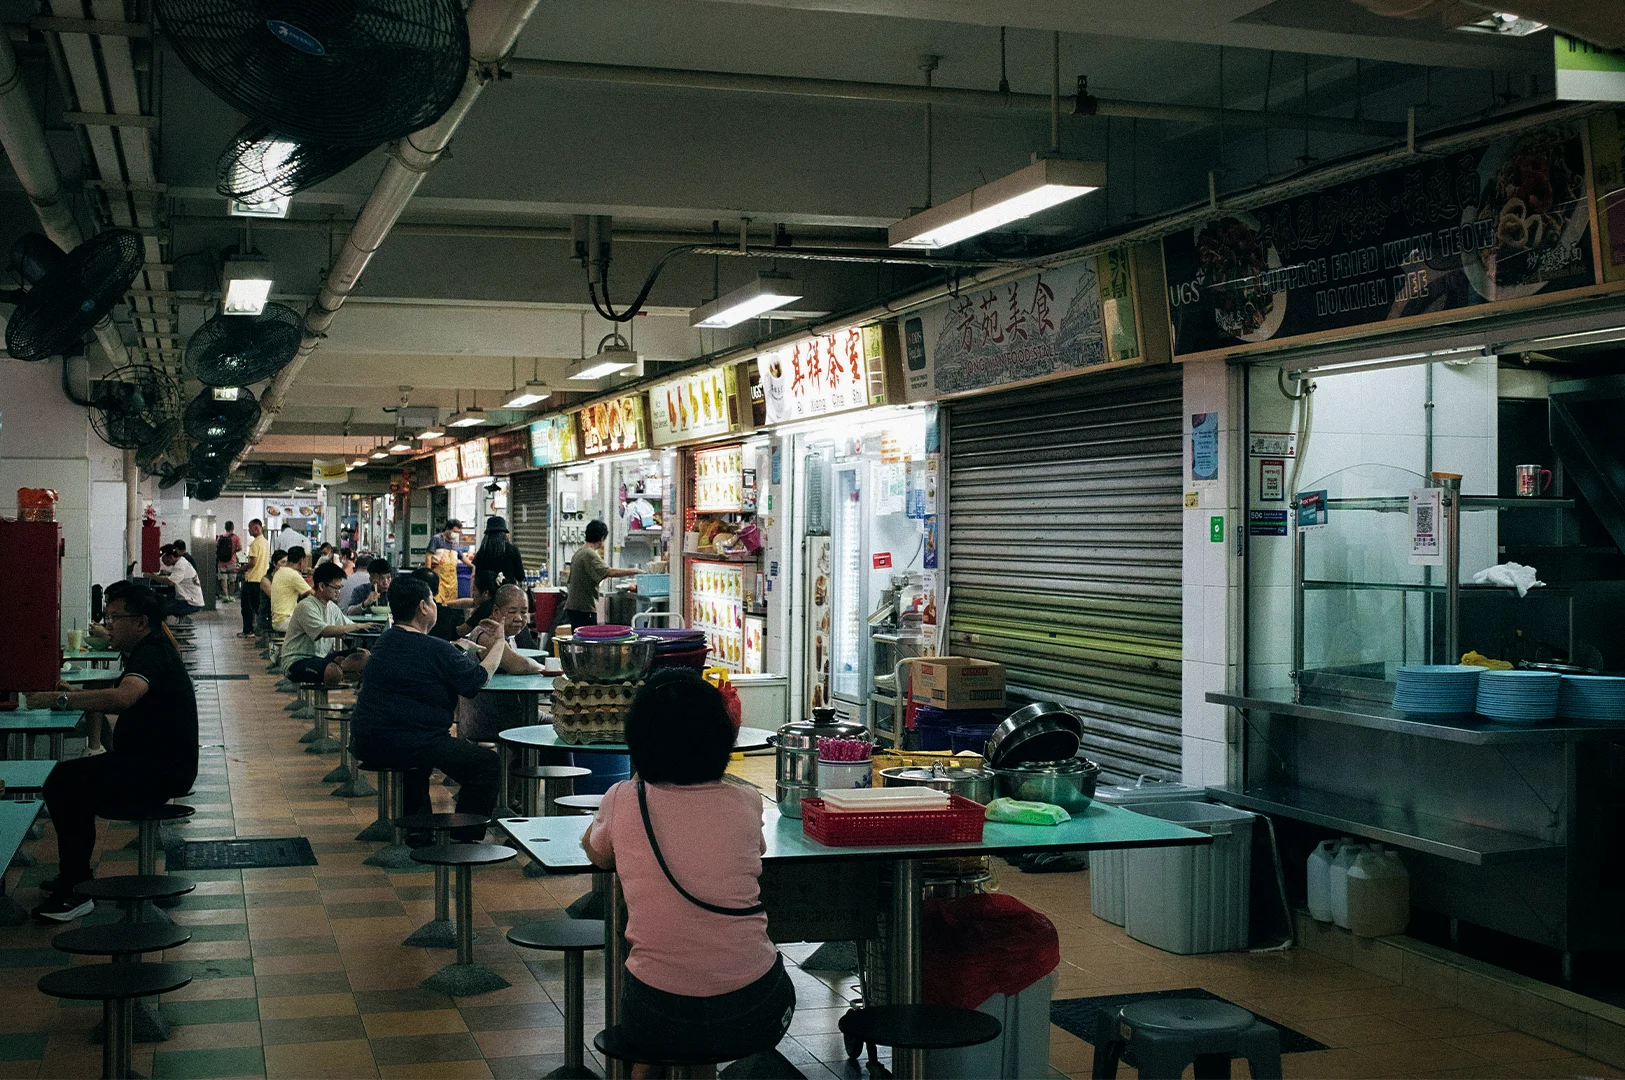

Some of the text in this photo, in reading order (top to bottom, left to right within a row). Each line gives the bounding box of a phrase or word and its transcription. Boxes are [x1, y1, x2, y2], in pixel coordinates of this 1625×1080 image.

[1258, 219, 1494, 295] CUPPAGE FRIED KWAY TEOW
[956, 273, 1054, 352] 芳苑美食
[1316, 270, 1429, 316] HOKKIEN MEE
[1005, 347, 1031, 365] FOOD
